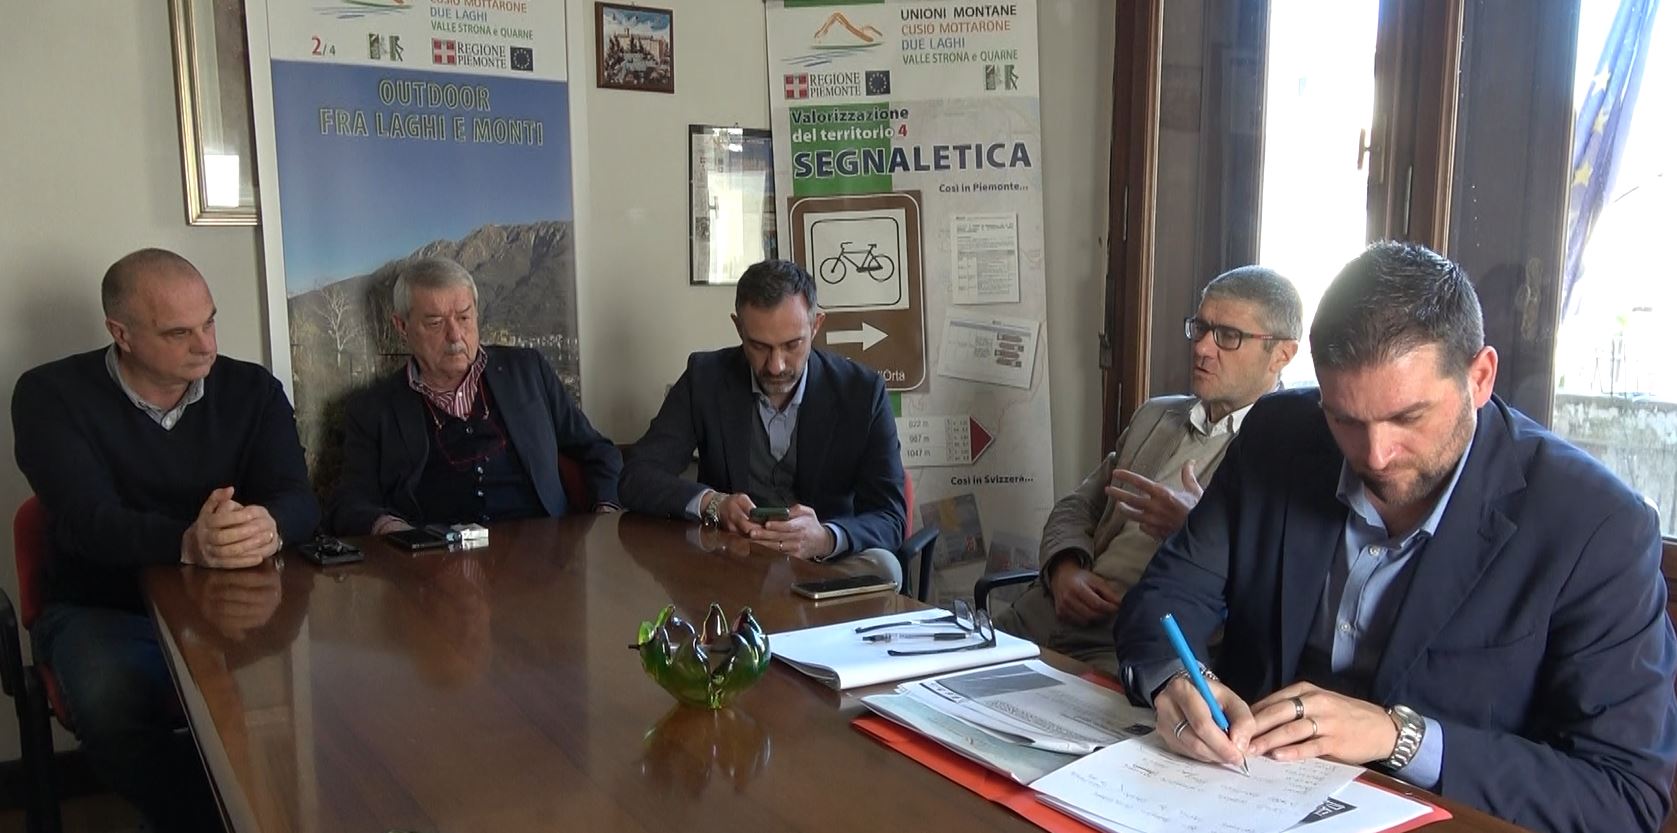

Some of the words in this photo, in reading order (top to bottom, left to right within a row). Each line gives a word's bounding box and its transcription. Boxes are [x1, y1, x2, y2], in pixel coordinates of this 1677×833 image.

[430, 7, 452, 18] DUE
[456, 10, 487, 22] LAGHI
[900, 8, 947, 20] UNIONI
[953, 5, 1017, 18] MONTANE
[431, 20, 456, 33] VALLE
[459, 23, 491, 36] STRONA
[500, 27, 533, 40] QUARNE
[901, 23, 935, 35] CUSIO
[940, 20, 1011, 32] MOTTARONE
[457, 41, 505, 57] REGIONE
[901, 39, 926, 51] DUE
[930, 37, 965, 50] LAGHI
[457, 54, 507, 69] PIEMONTE
[902, 53, 930, 65] VALLE
[932, 52, 970, 63] STRONA
[980, 49, 1018, 61] QUARNE
[809, 72, 861, 87] REGIONE
[379, 79, 491, 112] OUTDOOR
[810, 84, 861, 98] PIEMONTE
[791, 107, 909, 124] Valorizzazione
[319, 108, 369, 137] FRA
[375, 112, 447, 142] LAGHI
[453, 116, 467, 142] E
[473, 117, 545, 147] MONTI
[792, 128, 817, 143] del
[820, 124, 895, 142] territorio
[898, 124, 908, 137] 4
[793, 142, 1032, 179] SEGNALETICA
[961, 183, 971, 192] in
[973, 475, 982, 485] in
